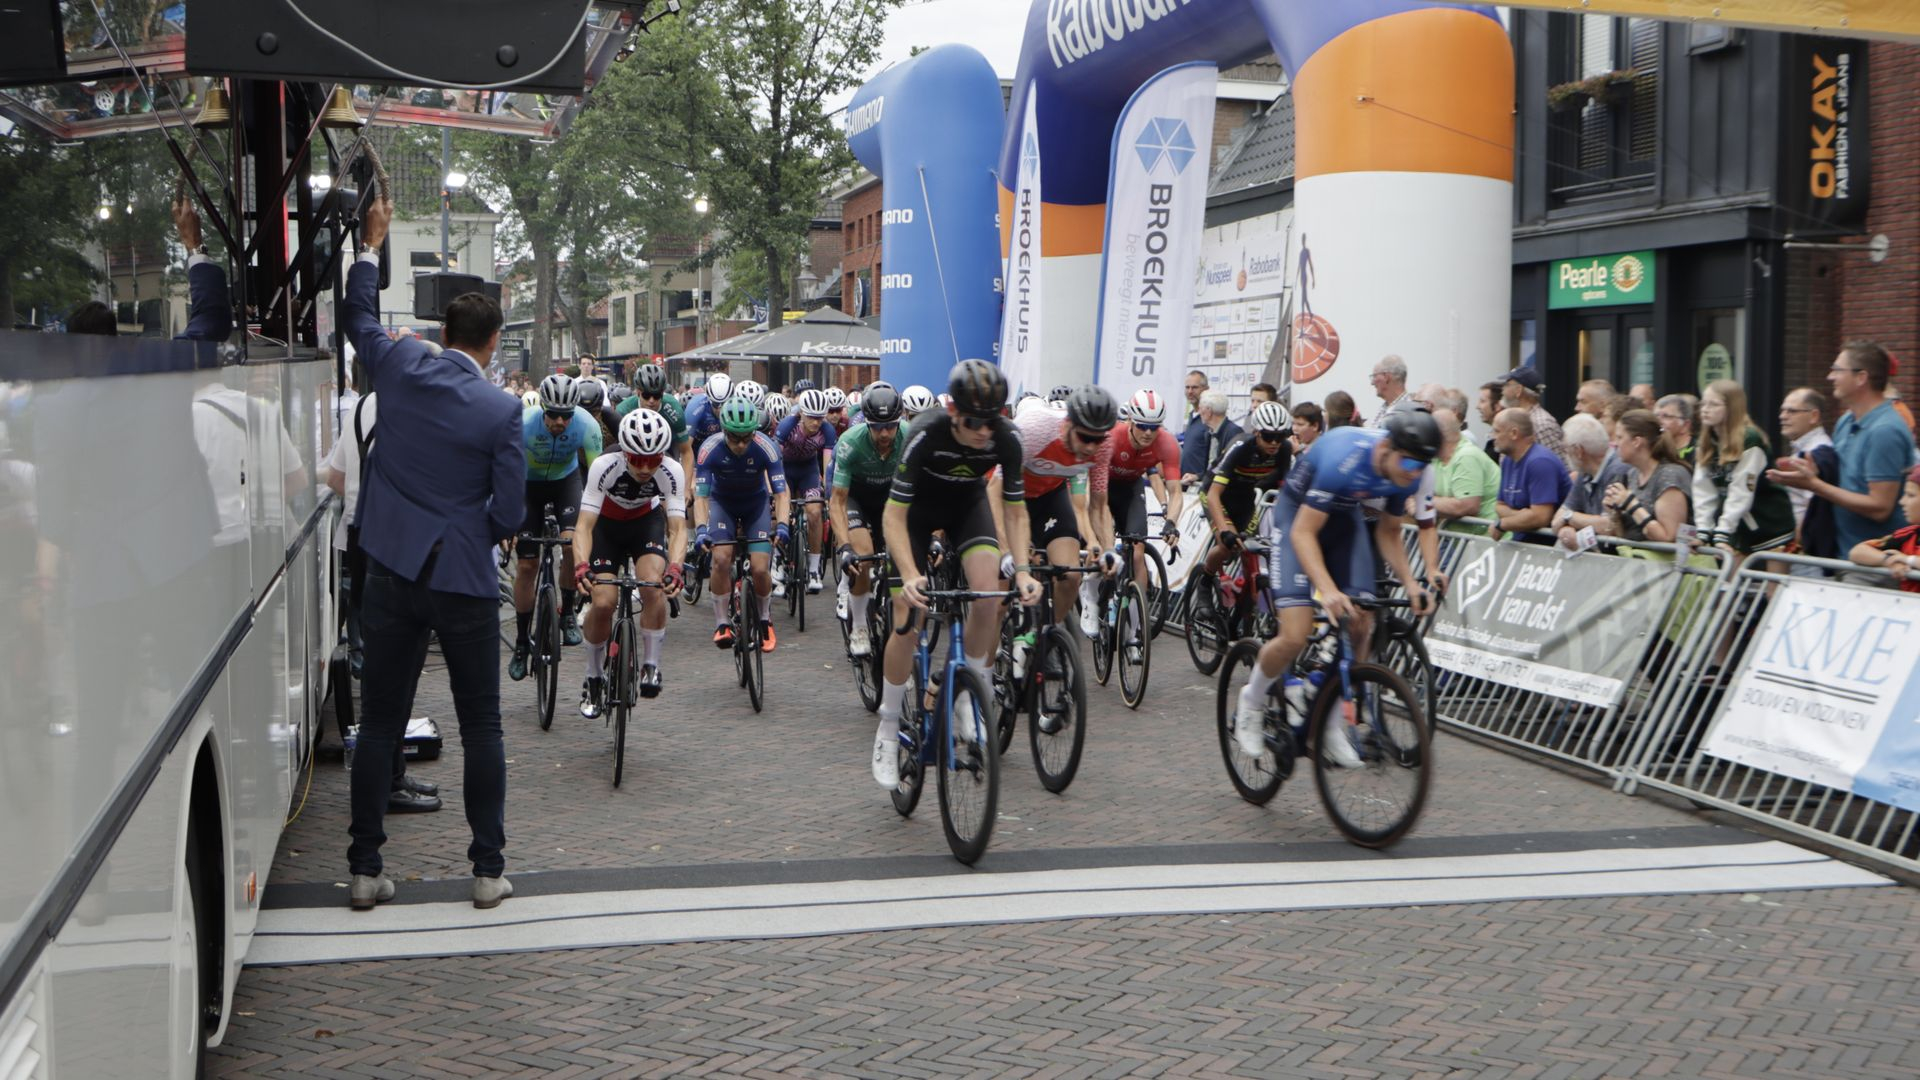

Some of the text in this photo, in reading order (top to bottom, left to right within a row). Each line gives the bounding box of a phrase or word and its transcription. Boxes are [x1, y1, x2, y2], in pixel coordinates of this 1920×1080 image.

[1047, 0, 1191, 69] Rabob
[1836, 53, 1850, 108] JEANS
[1810, 53, 1838, 198] OKAY
[1835, 127, 1849, 199] FASHION
[1018, 189, 1031, 353] BROEKHUIS
[1131, 183, 1173, 376] BROEKHUIS
[1249, 252, 1281, 275] Rabobank
[1560, 260, 1608, 289] Pearle
[1115, 233, 1140, 370] beweegt mensen
[1507, 554, 1563, 595] jacob
[1498, 595, 1567, 631] van olst
[1762, 602, 1912, 686] KME
[1742, 687, 1782, 708] BOUW
[1781, 696, 1803, 715] EN
